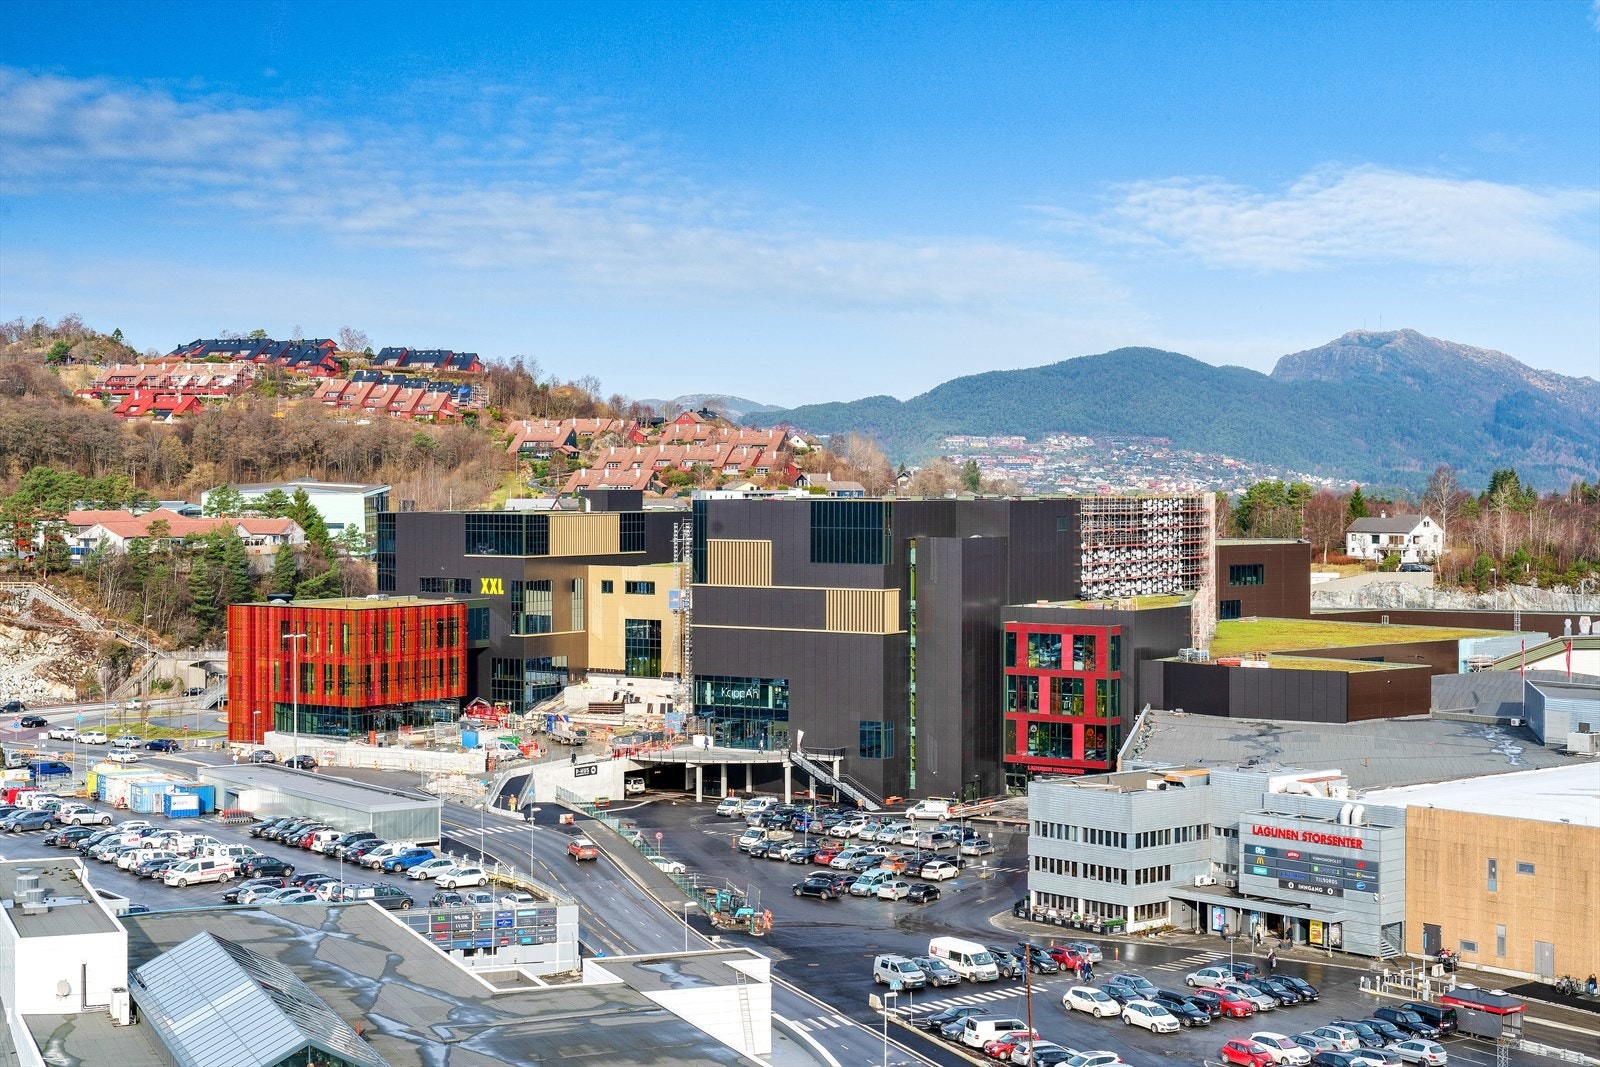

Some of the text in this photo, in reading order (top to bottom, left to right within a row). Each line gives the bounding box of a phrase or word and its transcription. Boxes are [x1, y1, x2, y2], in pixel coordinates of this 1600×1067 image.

[480, 577, 505, 595] XXL
[1252, 824, 1363, 849] LAGUNEN STORSENTER
[1298, 883, 1323, 893] INNGANG
